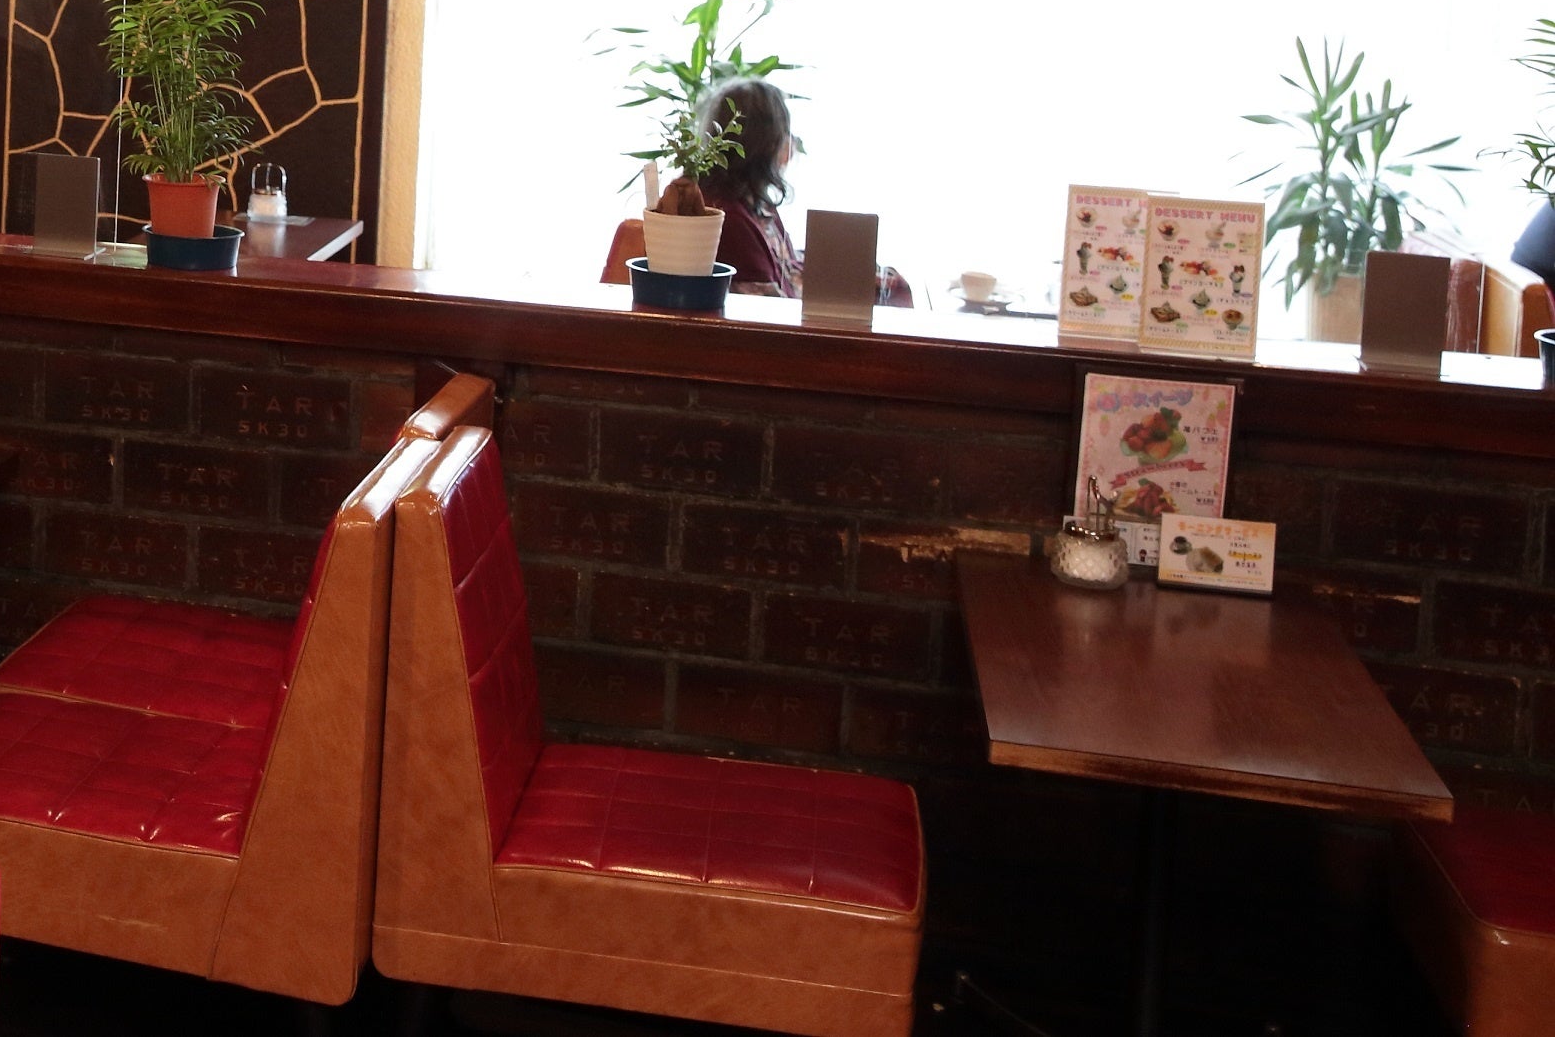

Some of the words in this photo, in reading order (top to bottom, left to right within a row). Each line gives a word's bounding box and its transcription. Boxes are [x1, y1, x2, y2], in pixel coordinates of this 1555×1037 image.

[1076, 195, 1132, 208] DESSERT
[1154, 207, 1212, 220] DESSERT
[1220, 213, 1257, 224] MENU
[236, 391, 313, 416] TAR
[637, 434, 724, 461] TAR
